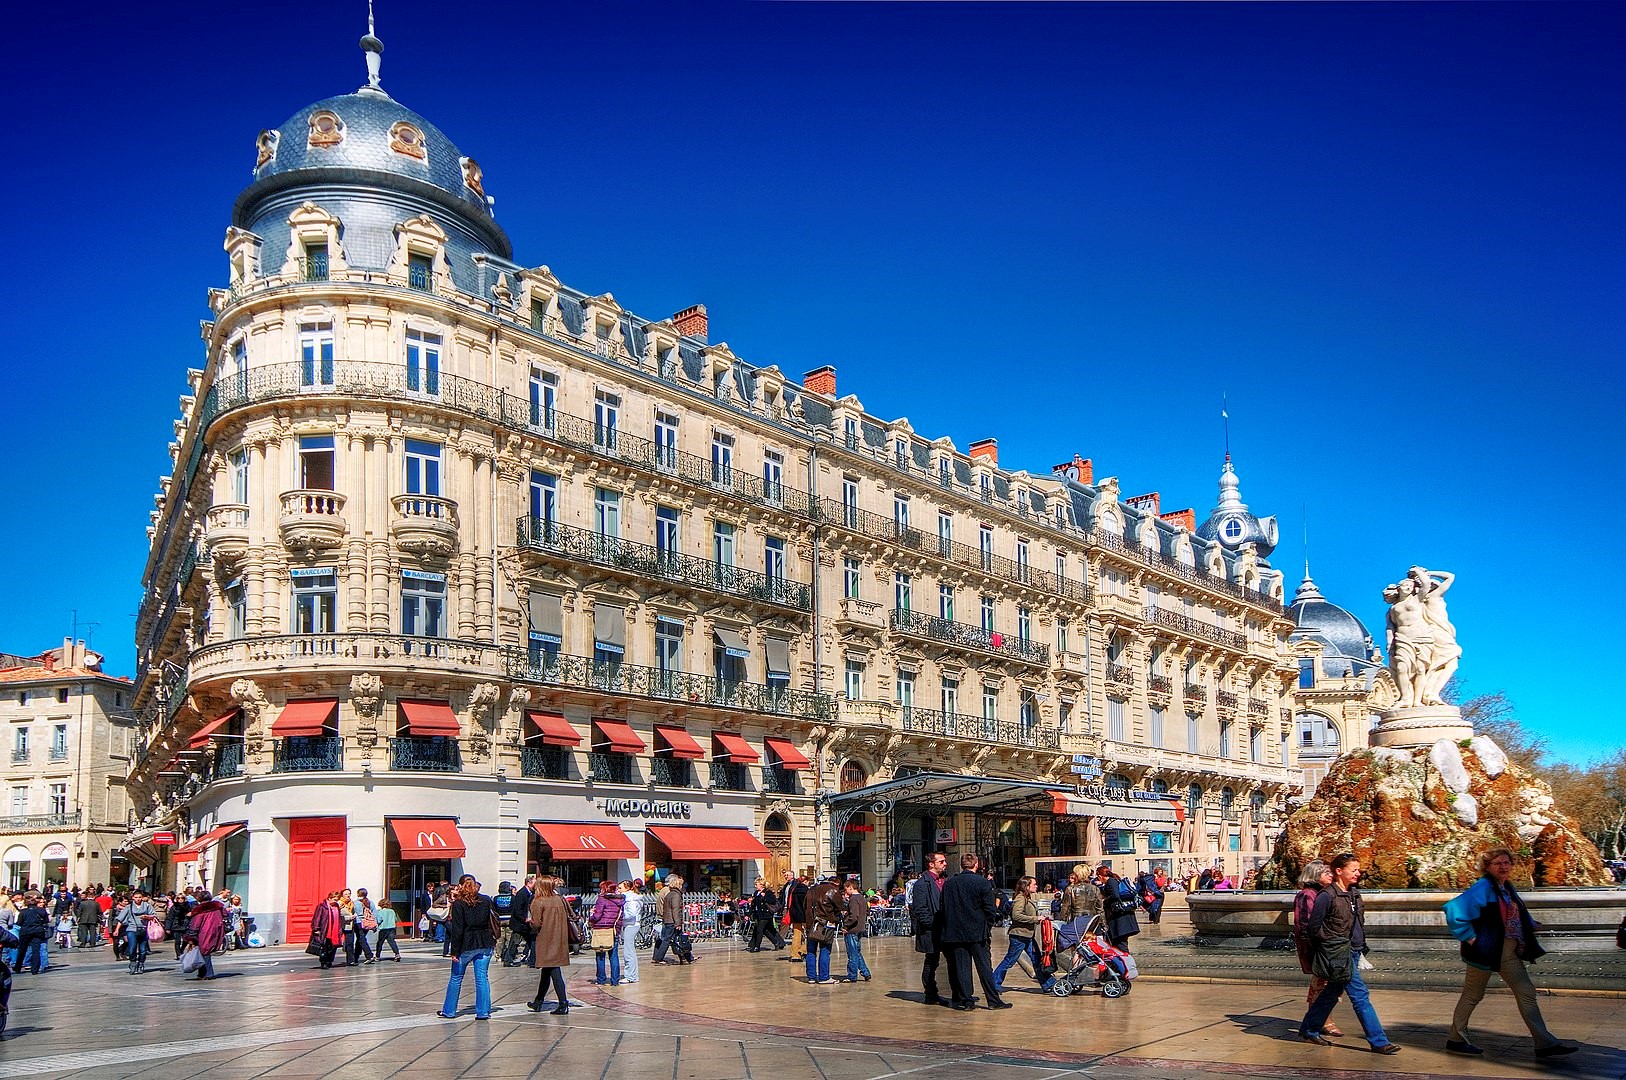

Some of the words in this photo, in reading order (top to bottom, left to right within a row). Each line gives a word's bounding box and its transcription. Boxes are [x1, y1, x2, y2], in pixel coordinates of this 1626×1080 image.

[411, 571, 444, 580] BARCLAYS
[1088, 785, 1107, 799] Café
[605, 799, 691, 815] McDonald's
